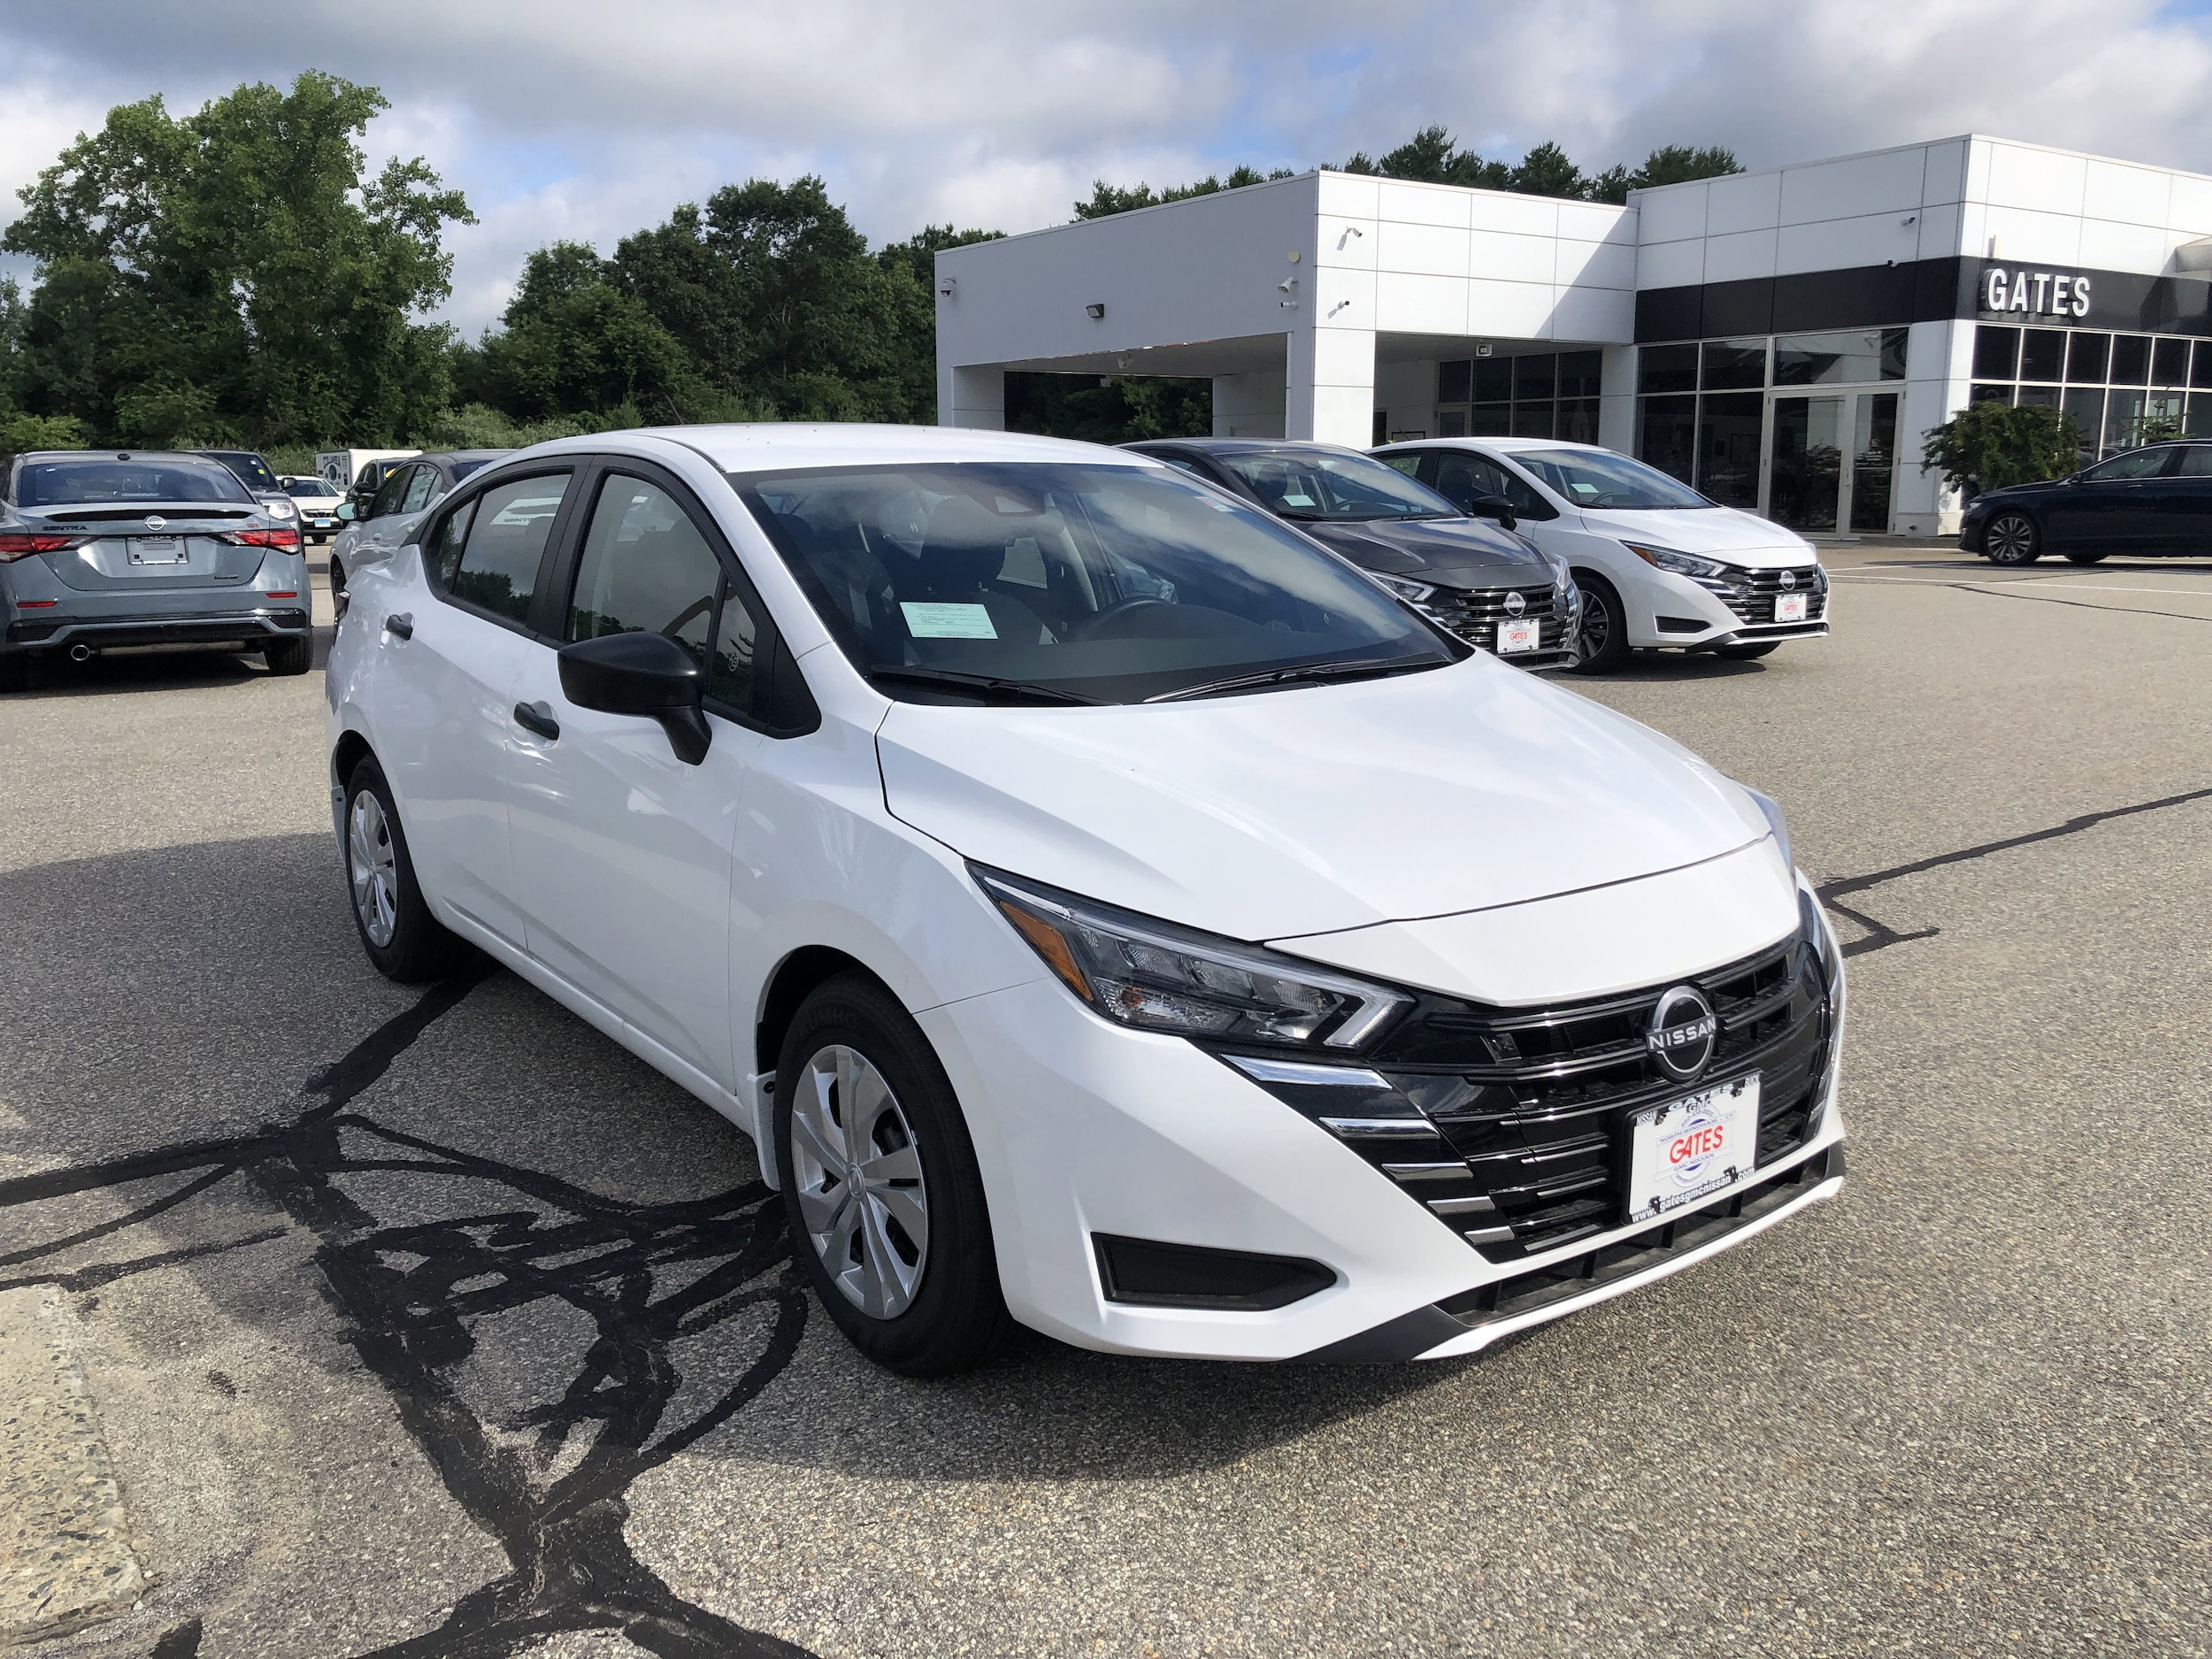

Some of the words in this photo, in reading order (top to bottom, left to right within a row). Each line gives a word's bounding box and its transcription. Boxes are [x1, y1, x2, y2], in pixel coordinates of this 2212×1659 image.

[1987, 268, 2091, 318] GATES
[1509, 632, 1528, 641] GATES
[1648, 1017, 1717, 1050] NISSAN
[1668, 1083, 1735, 1111] GATES
[1687, 1098, 1714, 1113] GMC
[1670, 1125, 1724, 1164] GATES
